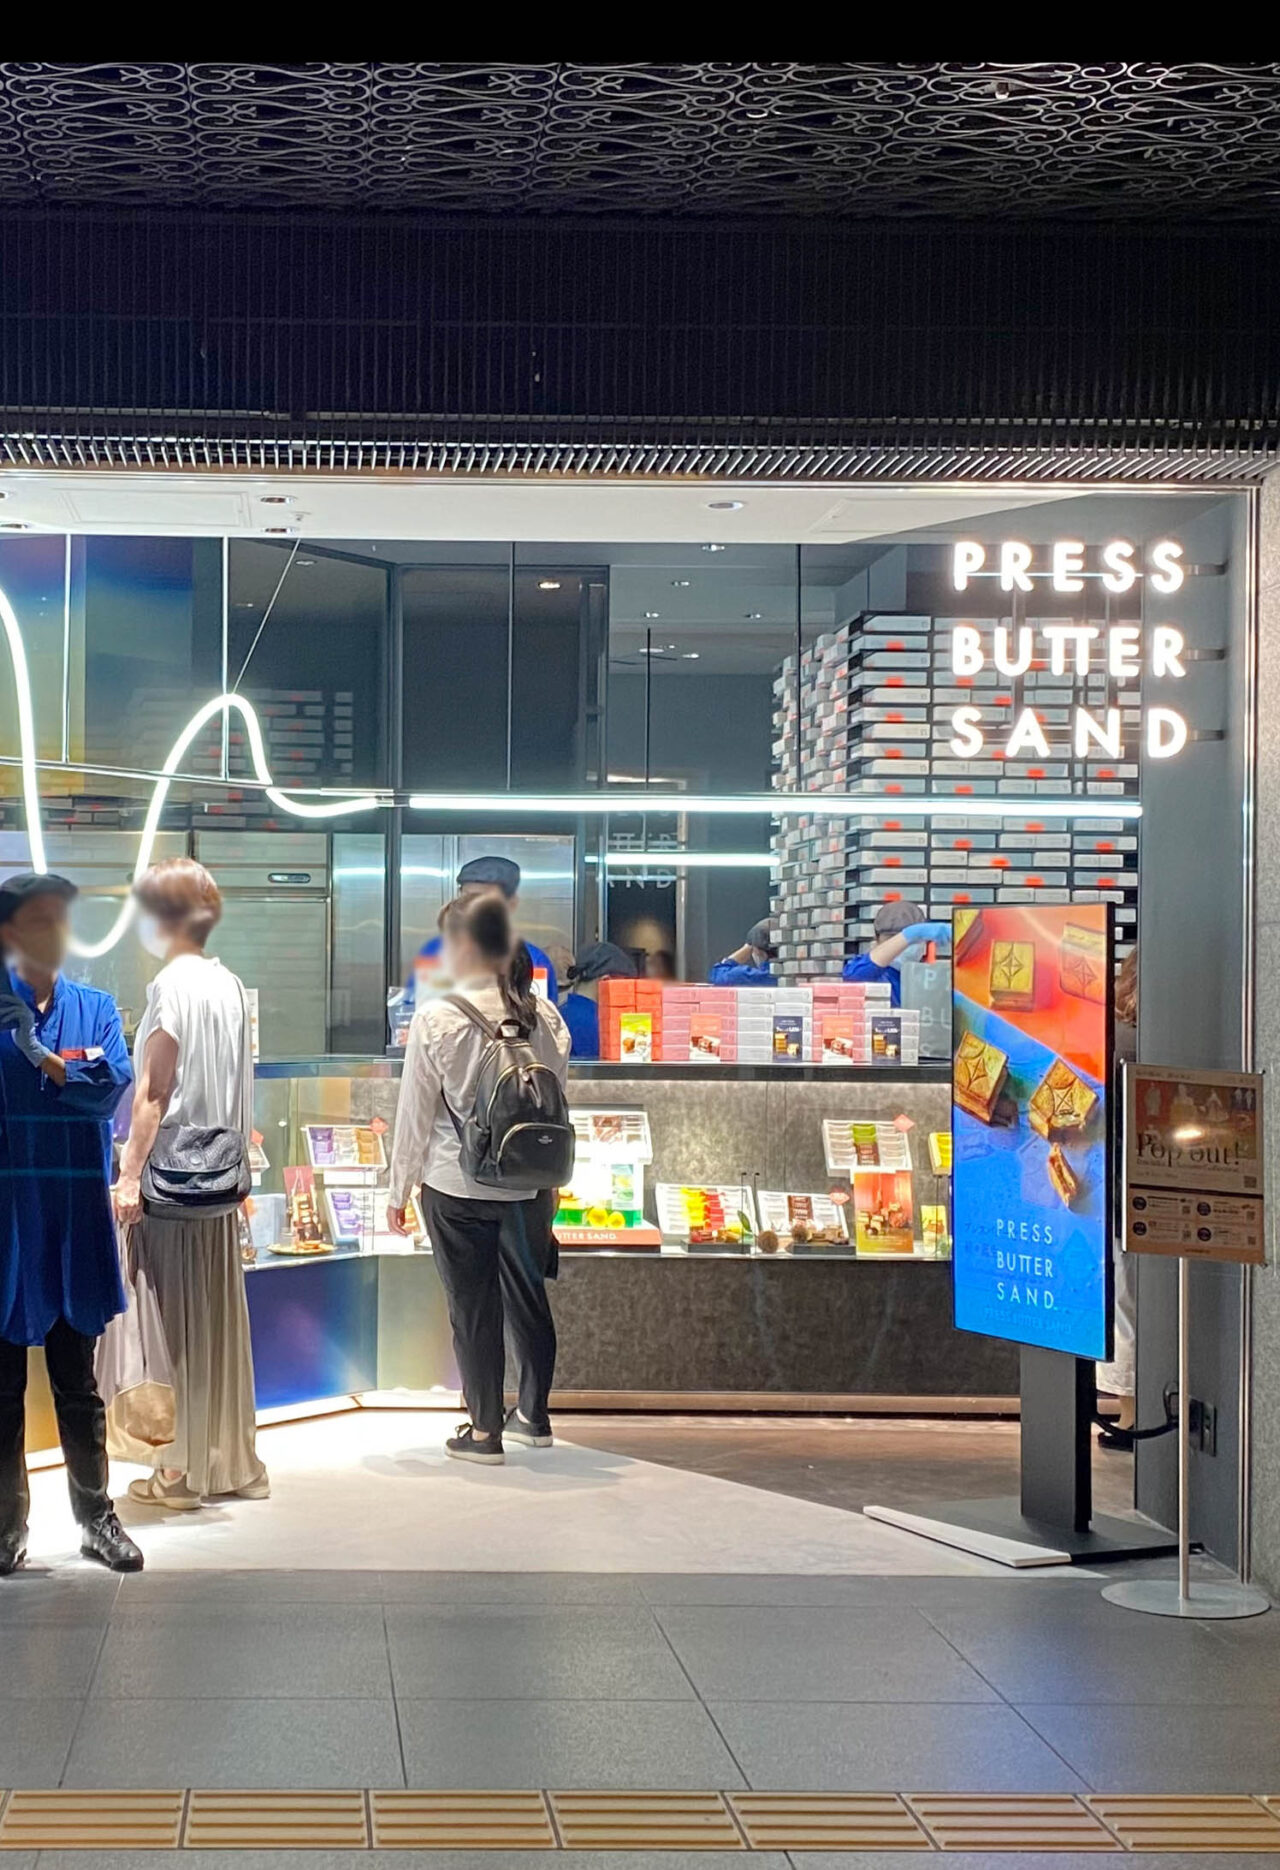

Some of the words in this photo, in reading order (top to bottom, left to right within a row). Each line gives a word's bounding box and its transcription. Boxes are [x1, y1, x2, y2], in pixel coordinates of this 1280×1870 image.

[953, 541, 1184, 593] PRESS
[951, 626, 1186, 677] BUTTER
[950, 706, 1188, 759] SAND
[1137, 1133, 1182, 1168] Pop
[1190, 1141, 1239, 1165] out!
[996, 1218, 1053, 1245] PRESS
[996, 1250, 1053, 1278] BUTTER
[996, 1282, 1058, 1310] SAND.
